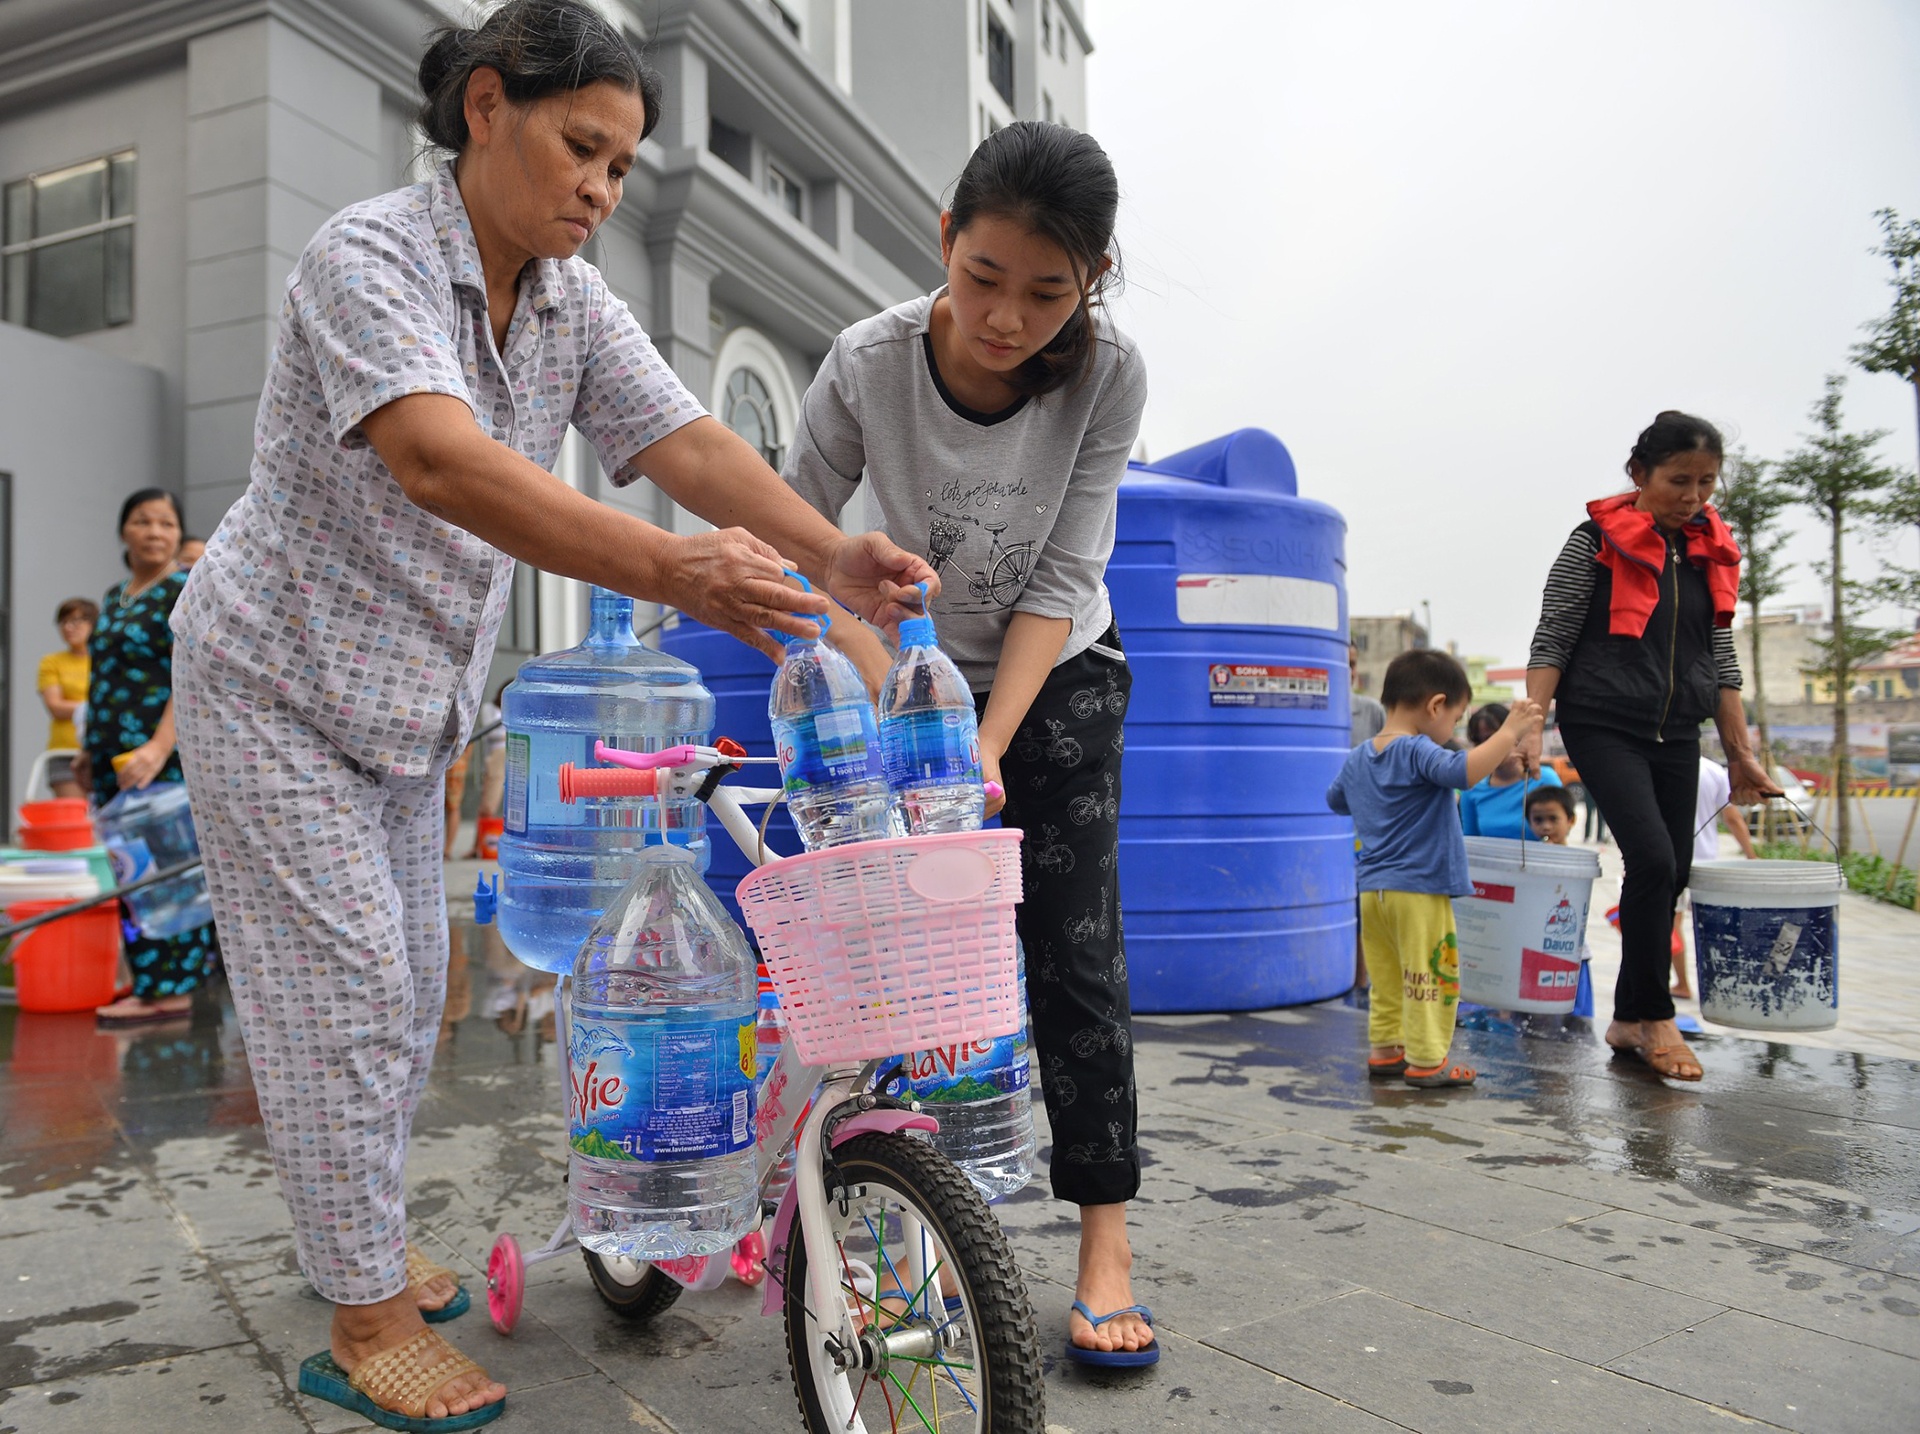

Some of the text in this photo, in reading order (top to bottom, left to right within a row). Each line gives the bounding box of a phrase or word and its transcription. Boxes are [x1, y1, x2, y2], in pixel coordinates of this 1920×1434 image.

[1542, 937, 1575, 952] Davco
[569, 1062, 625, 1126] aVie
[623, 1134, 633, 1154] 6
[635, 1135, 644, 1154] L
[653, 1143, 719, 1154] www.laviewater.com
